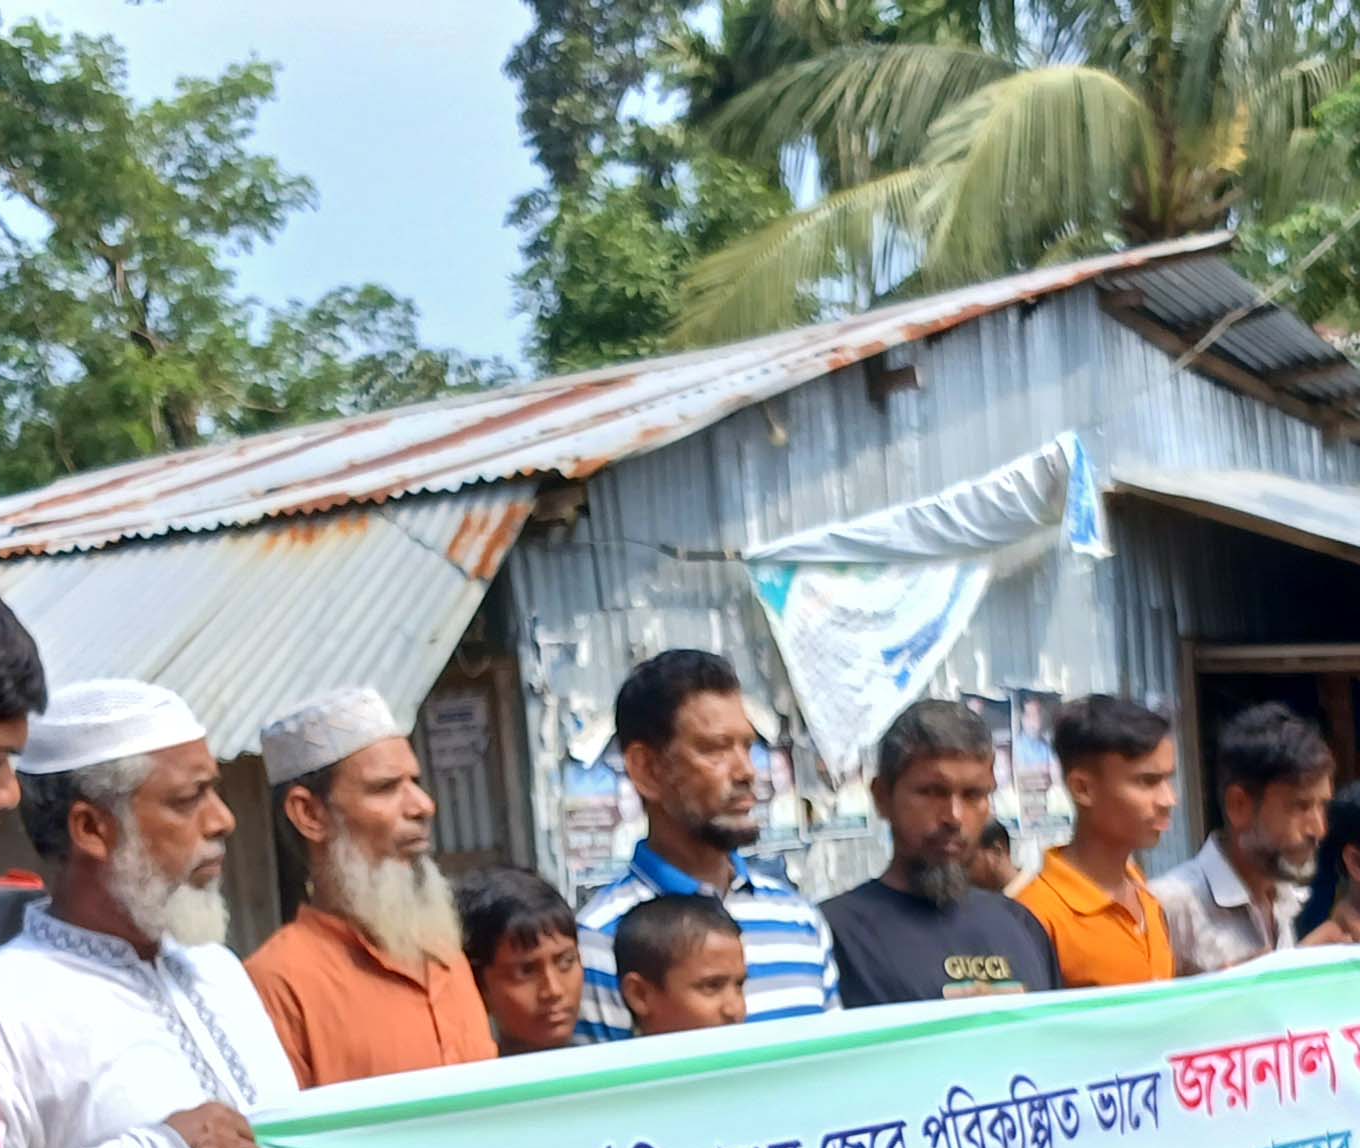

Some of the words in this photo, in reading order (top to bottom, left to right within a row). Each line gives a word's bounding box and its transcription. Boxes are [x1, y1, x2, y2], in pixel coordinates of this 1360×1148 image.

[944, 956, 1012, 981] GUCCI
[1086, 1071, 1166, 1136] ভাবে
[1168, 1030, 1337, 1117] জয়নাল
